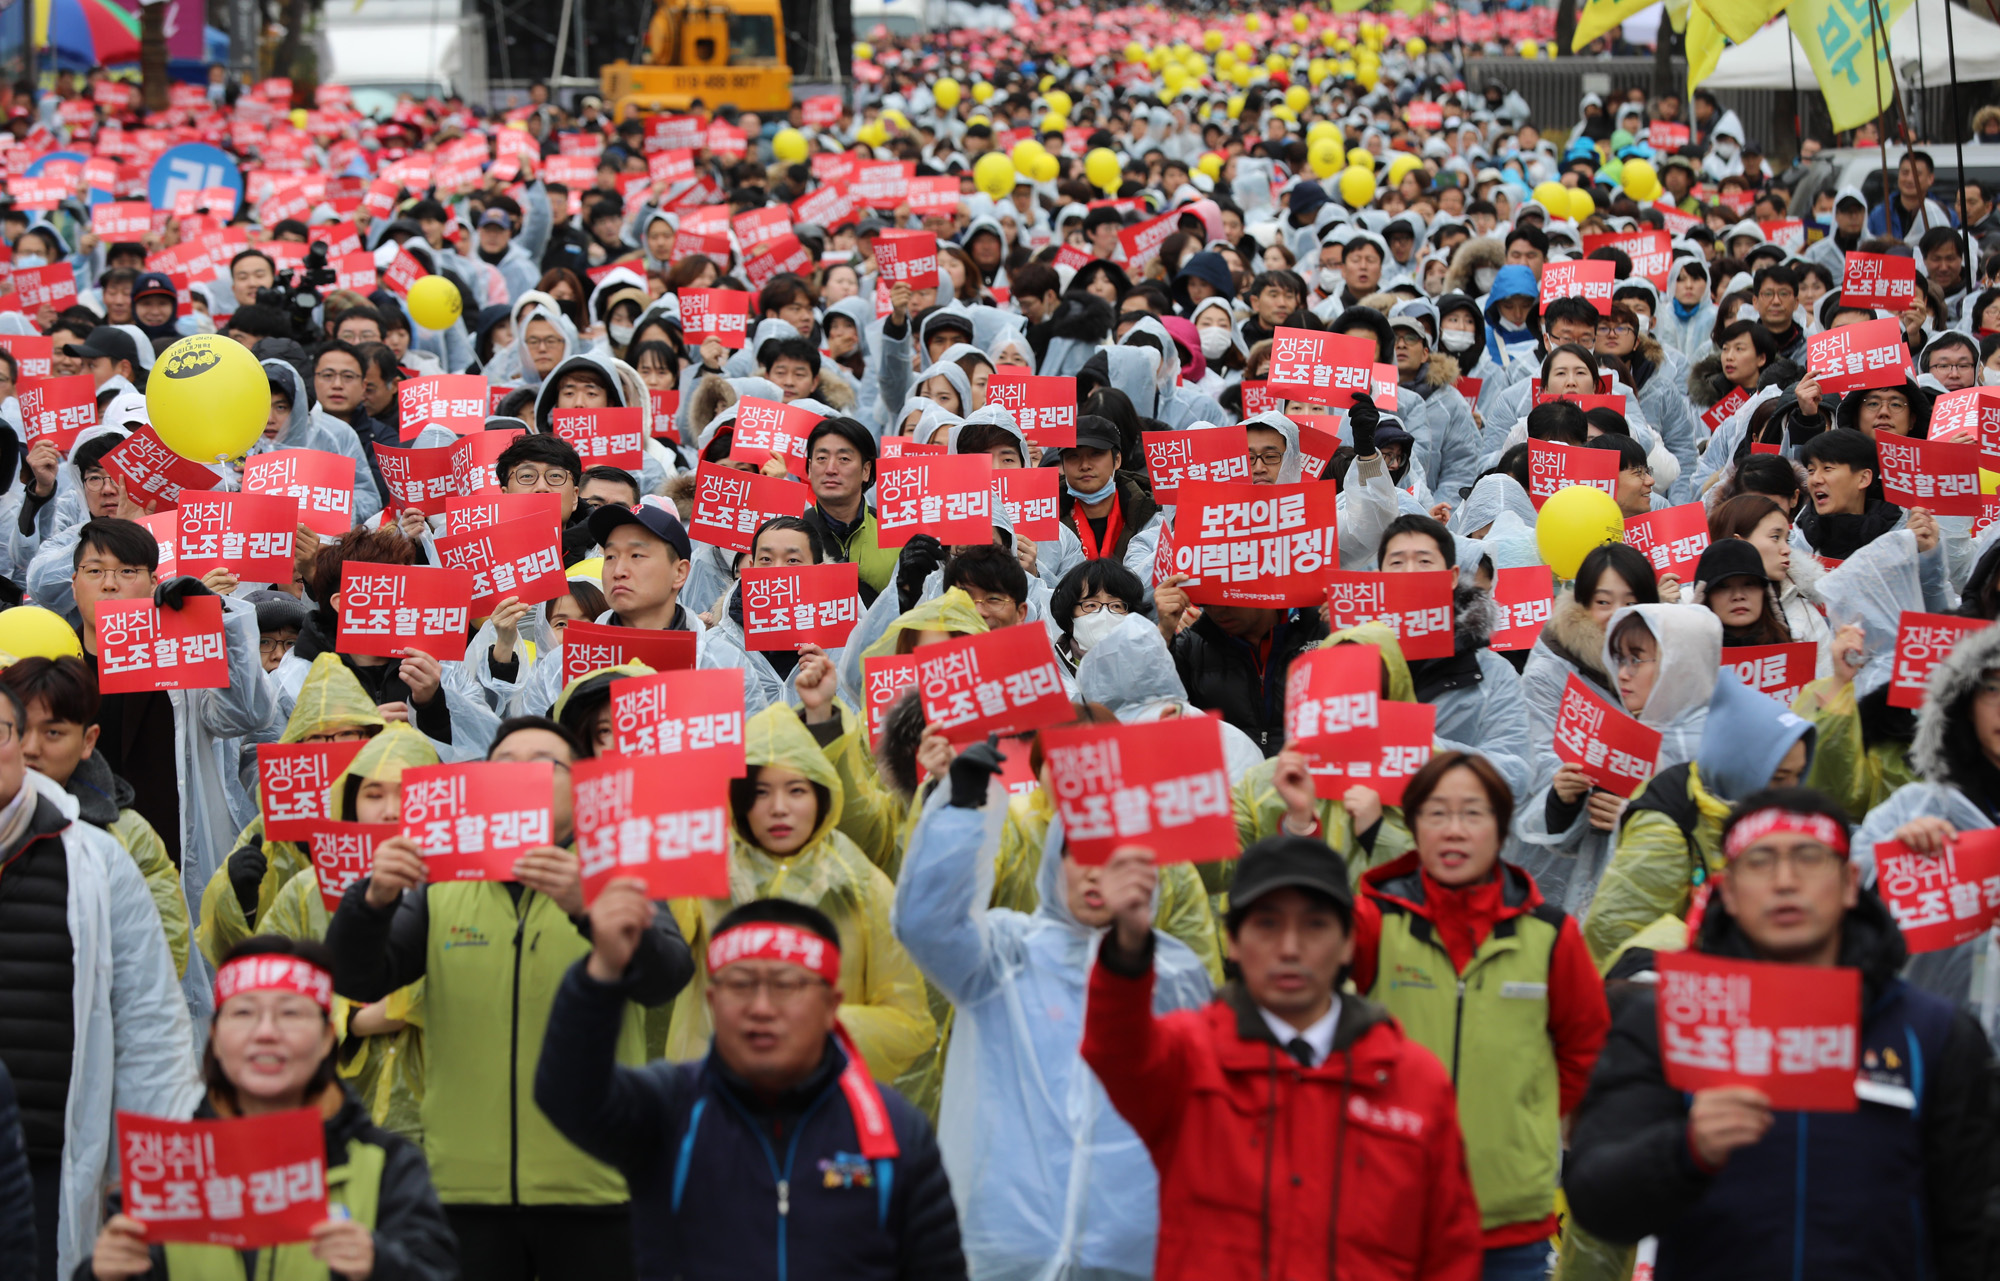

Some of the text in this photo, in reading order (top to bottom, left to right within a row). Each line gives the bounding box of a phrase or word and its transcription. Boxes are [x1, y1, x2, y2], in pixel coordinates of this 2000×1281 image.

[874, 243, 897, 269] 쟁취!
[881, 255, 936, 280] 노조 할 권리
[1848, 259, 1882, 279] 쟁취!
[50, 281, 76, 300] 권리
[1545, 266, 1576, 287] 쟁취!
[1584, 282, 1612, 299] 권리
[1845, 280, 1915, 297] 노조 할 권리
[680, 294, 709, 316] 쟁취!
[1542, 283, 1611, 304] 노조 권리
[682, 313, 745, 333] 노조 할 권리
[1275, 338, 1324, 363] 쟁취!
[1810, 332, 1850, 361] 쟁취!
[1847, 352, 1865, 374] 할
[1868, 344, 1901, 368] 권리
[22, 359, 50, 376] 권리
[1271, 363, 1370, 389] 노조 할 권리
[20, 388, 44, 418] 쟁취!
[401, 381, 439, 408] 쟁취!
[990, 383, 1026, 407] 쟁취!
[1935, 393, 1978, 420] 쟁취!
[40, 410, 58, 432] 할
[62, 404, 95, 430] 권리
[402, 399, 483, 428] 노조 할 권리
[557, 414, 597, 439] 쟁취!
[740, 405, 785, 430] 쟁취!
[1019, 406, 1074, 429] 할 권리
[1932, 416, 1962, 440] 노조
[133, 434, 178, 470] 쟁취!
[591, 432, 641, 455] 할 권리
[735, 429, 789, 453] 노조 할
[1148, 438, 1192, 468] 쟁취!
[111, 446, 167, 492] 노조 할
[377, 452, 410, 480] 쟁취!
[451, 443, 472, 480] 쟁취!
[1531, 449, 1566, 477] 쟁취!
[1880, 442, 1920, 472] 쟁취!
[248, 458, 297, 490] 쟁취!
[470, 466, 485, 491] 할
[880, 466, 929, 502] 쟁취!
[1153, 456, 1249, 490] 노조 권리
[1883, 472, 1979, 495] 노조 할 권리
[312, 488, 349, 514] 권리
[406, 477, 459, 502] 할 권리
[701, 474, 751, 507] 쟁취!
[1532, 479, 1557, 498] 노조
[181, 502, 232, 530] 쟁취!
[450, 504, 499, 536] 쟁취!
[694, 503, 757, 534] 노조 할
[881, 490, 988, 529] 노조 할 권리
[1023, 497, 1056, 523] 권리
[1202, 493, 1307, 538] 보건의료
[180, 531, 293, 560] 노조 할 권리
[442, 535, 495, 570] 쟁취!
[1176, 525, 1335, 587] 인력법제정!
[1652, 533, 1709, 570] 할 권리
[494, 545, 561, 591] 할 권리
[346, 576, 407, 606] 쟁취!
[747, 576, 800, 609] 쟁취!
[1331, 582, 1385, 613] 쟁취!
[101, 608, 162, 645] 쟁취!
[342, 606, 467, 635] 노조 할 권리
[748, 597, 856, 634] 노조 할 권리
[1407, 606, 1450, 638] 권리
[1514, 598, 1551, 627] 권리
[104, 633, 224, 674] 노조 할 권리
[567, 643, 622, 673] 쟁취!
[921, 648, 981, 699] 쟁취!
[1737, 653, 1787, 690] 의료
[615, 684, 666, 730] 쟁취!
[926, 662, 1061, 729] 노조 할 권리
[1300, 691, 1377, 738] 할 권리
[1564, 687, 1605, 738] 쟁취!
[618, 711, 742, 758] 노조 할 권리
[1556, 717, 1653, 781] 노조 할 권리
[264, 754, 328, 792] 쟁취!
[1048, 739, 1123, 800] 쟁취!
[1380, 746, 1429, 777] 권리
[268, 791, 320, 821] 노조
[404, 775, 466, 824] 쟁취!
[578, 769, 634, 833] 쟁취!
[1066, 770, 1227, 841] 노조 할 권리
[455, 809, 548, 853] 할 권리
[580, 806, 726, 878] 노조 할 권리
[312, 832, 372, 869] 쟁취!
[1881, 844, 1958, 897] 쟁취!
[1889, 881, 1981, 931] 노조 할
[1658, 971, 1752, 1025] 쟁취!
[1665, 1024, 1855, 1075] 노조 할 권리
[126, 1131, 215, 1180] 쟁취!
[131, 1157, 322, 1221] 노조 할 권리
